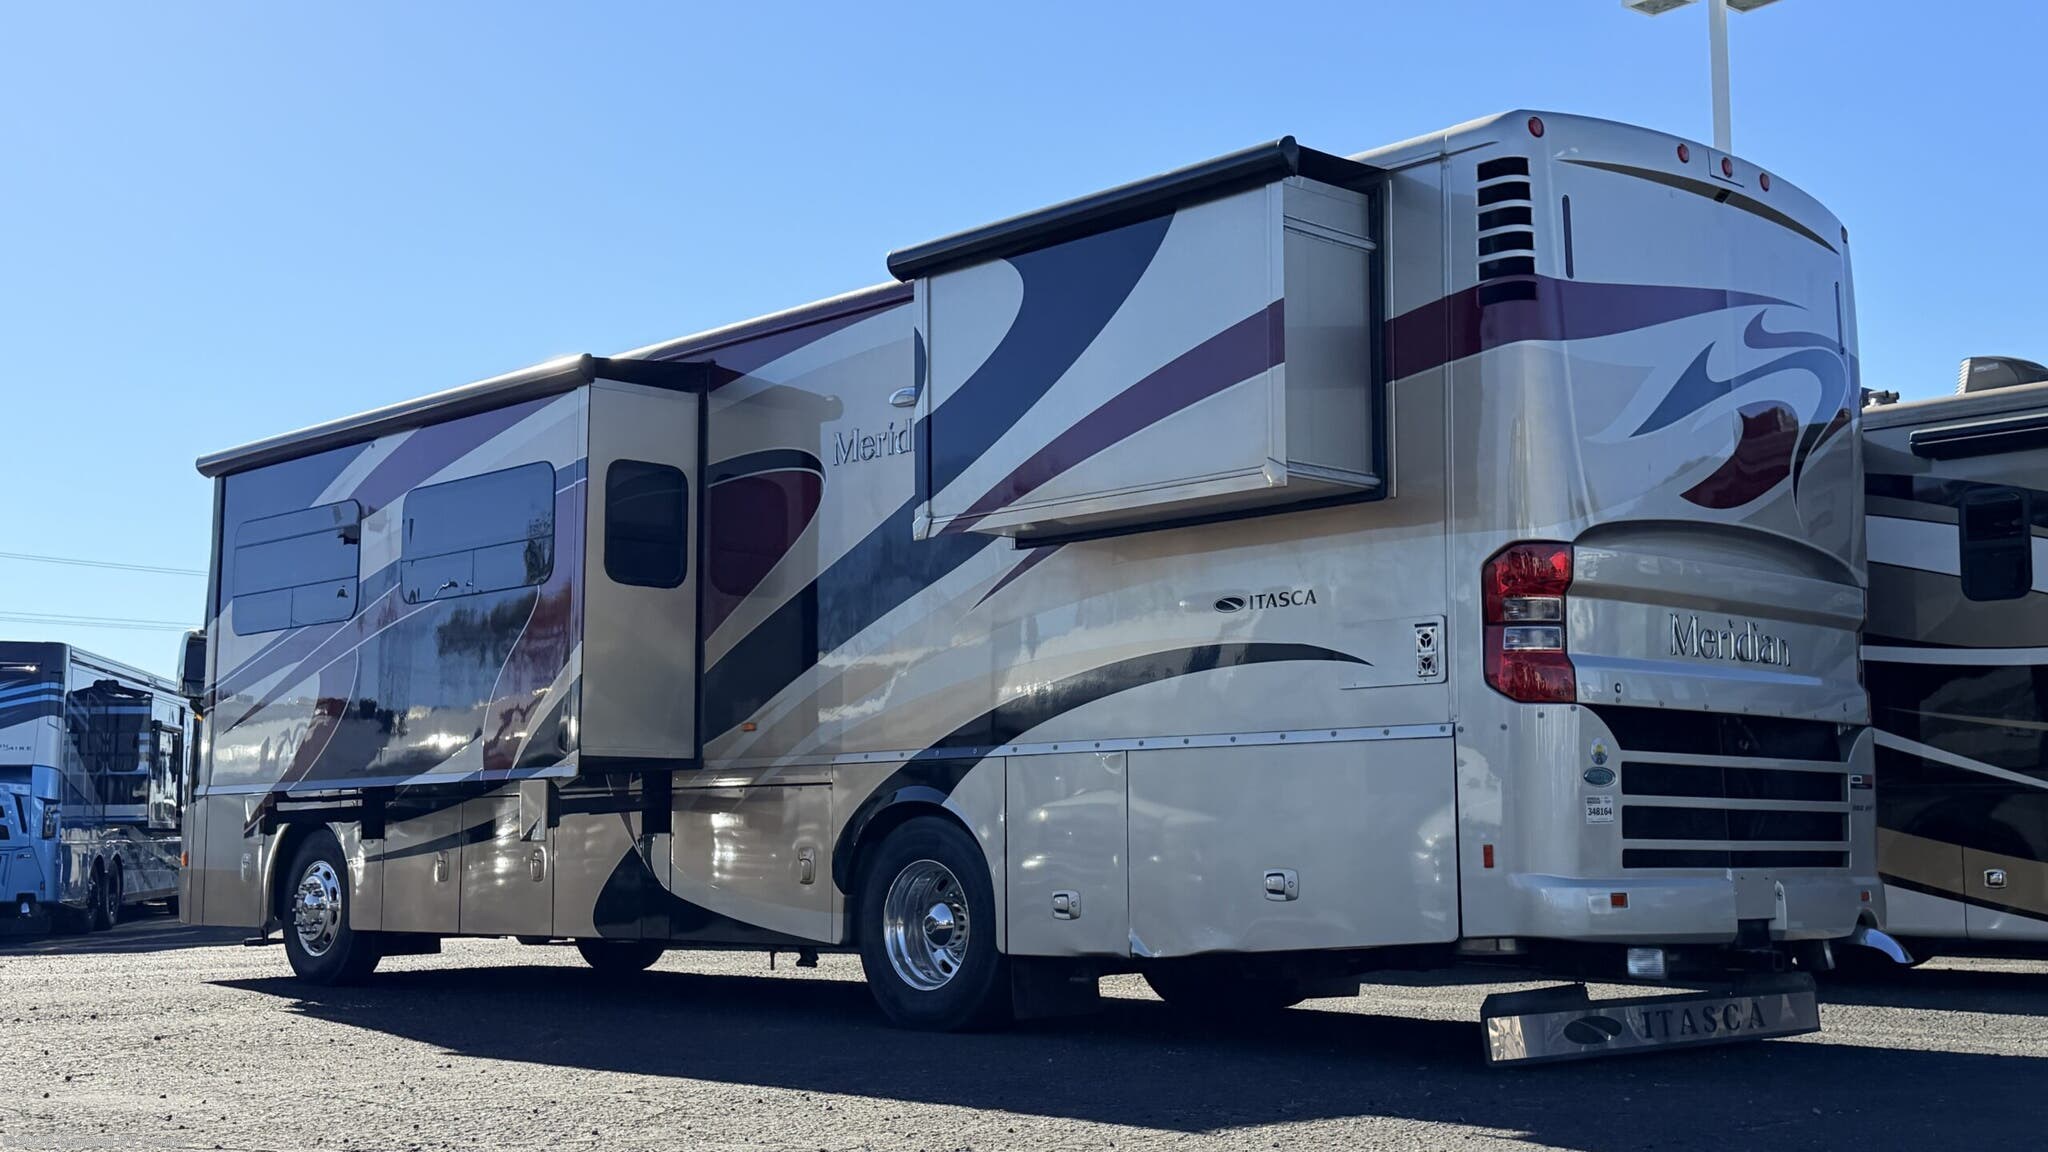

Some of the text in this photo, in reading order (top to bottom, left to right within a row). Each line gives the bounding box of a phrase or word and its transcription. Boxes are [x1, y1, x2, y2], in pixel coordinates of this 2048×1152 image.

[833, 418, 914, 466] Merid
[1249, 589, 1317, 610] ITASCA
[1670, 613, 1791, 667] Meridian
[1587, 807, 1612, 816] 348164
[1641, 1002, 1767, 1039] ITASCA
